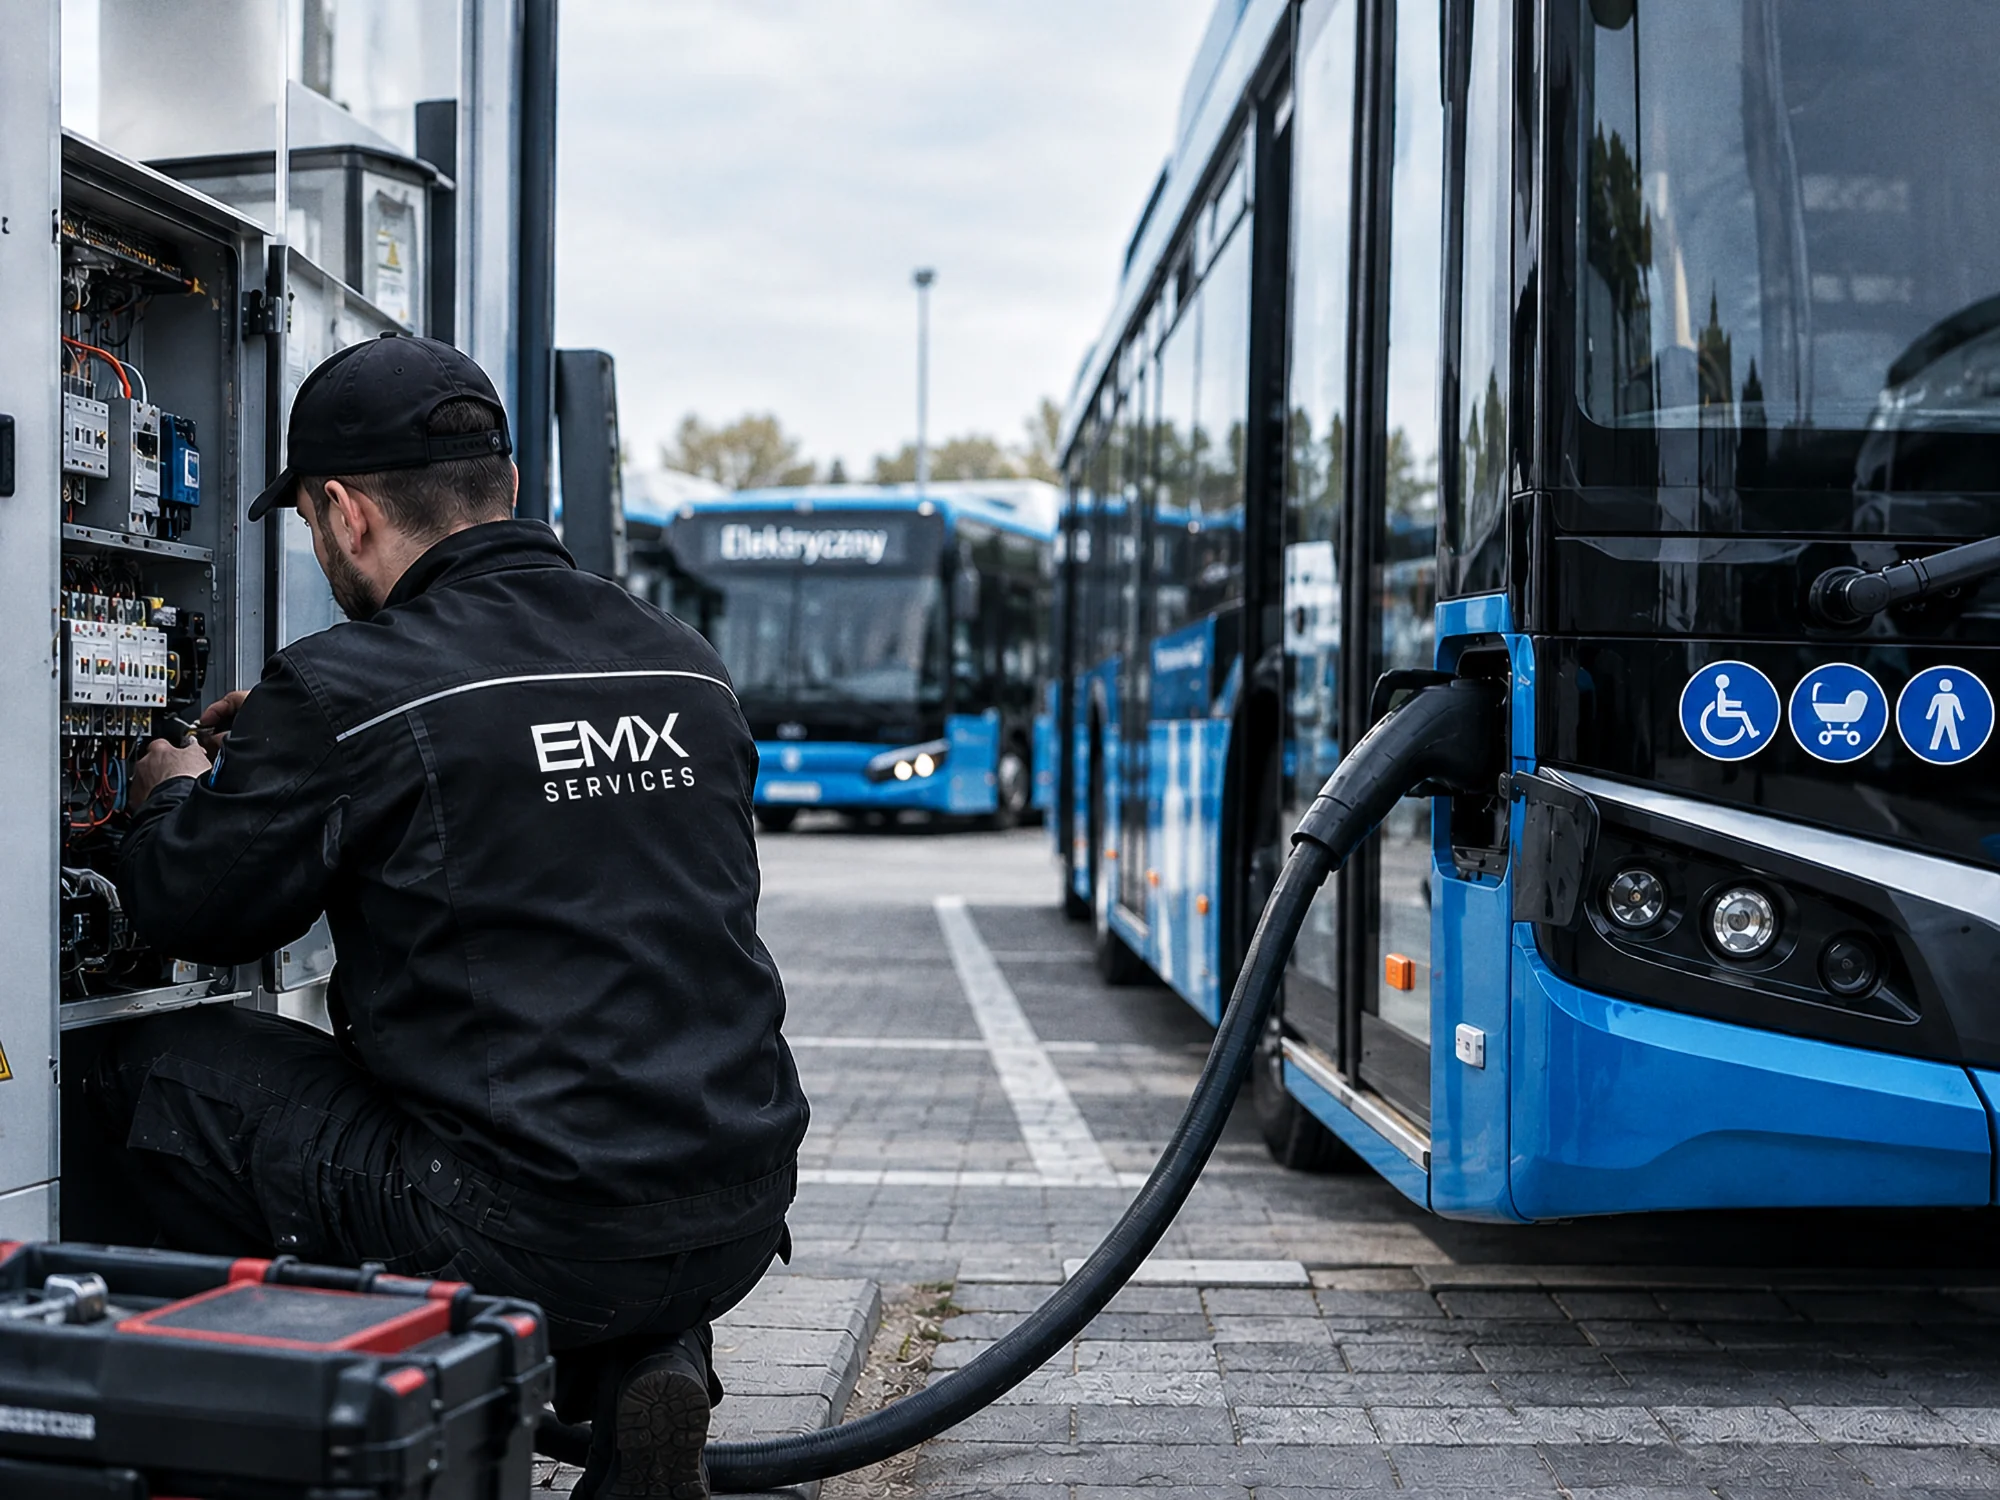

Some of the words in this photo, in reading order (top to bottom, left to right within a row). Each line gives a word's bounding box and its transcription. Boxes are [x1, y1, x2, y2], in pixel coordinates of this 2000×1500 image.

[721, 523, 888, 566] Elektryczny
[530, 712, 690, 772] EMX
[544, 767, 695, 802] SERVICES
